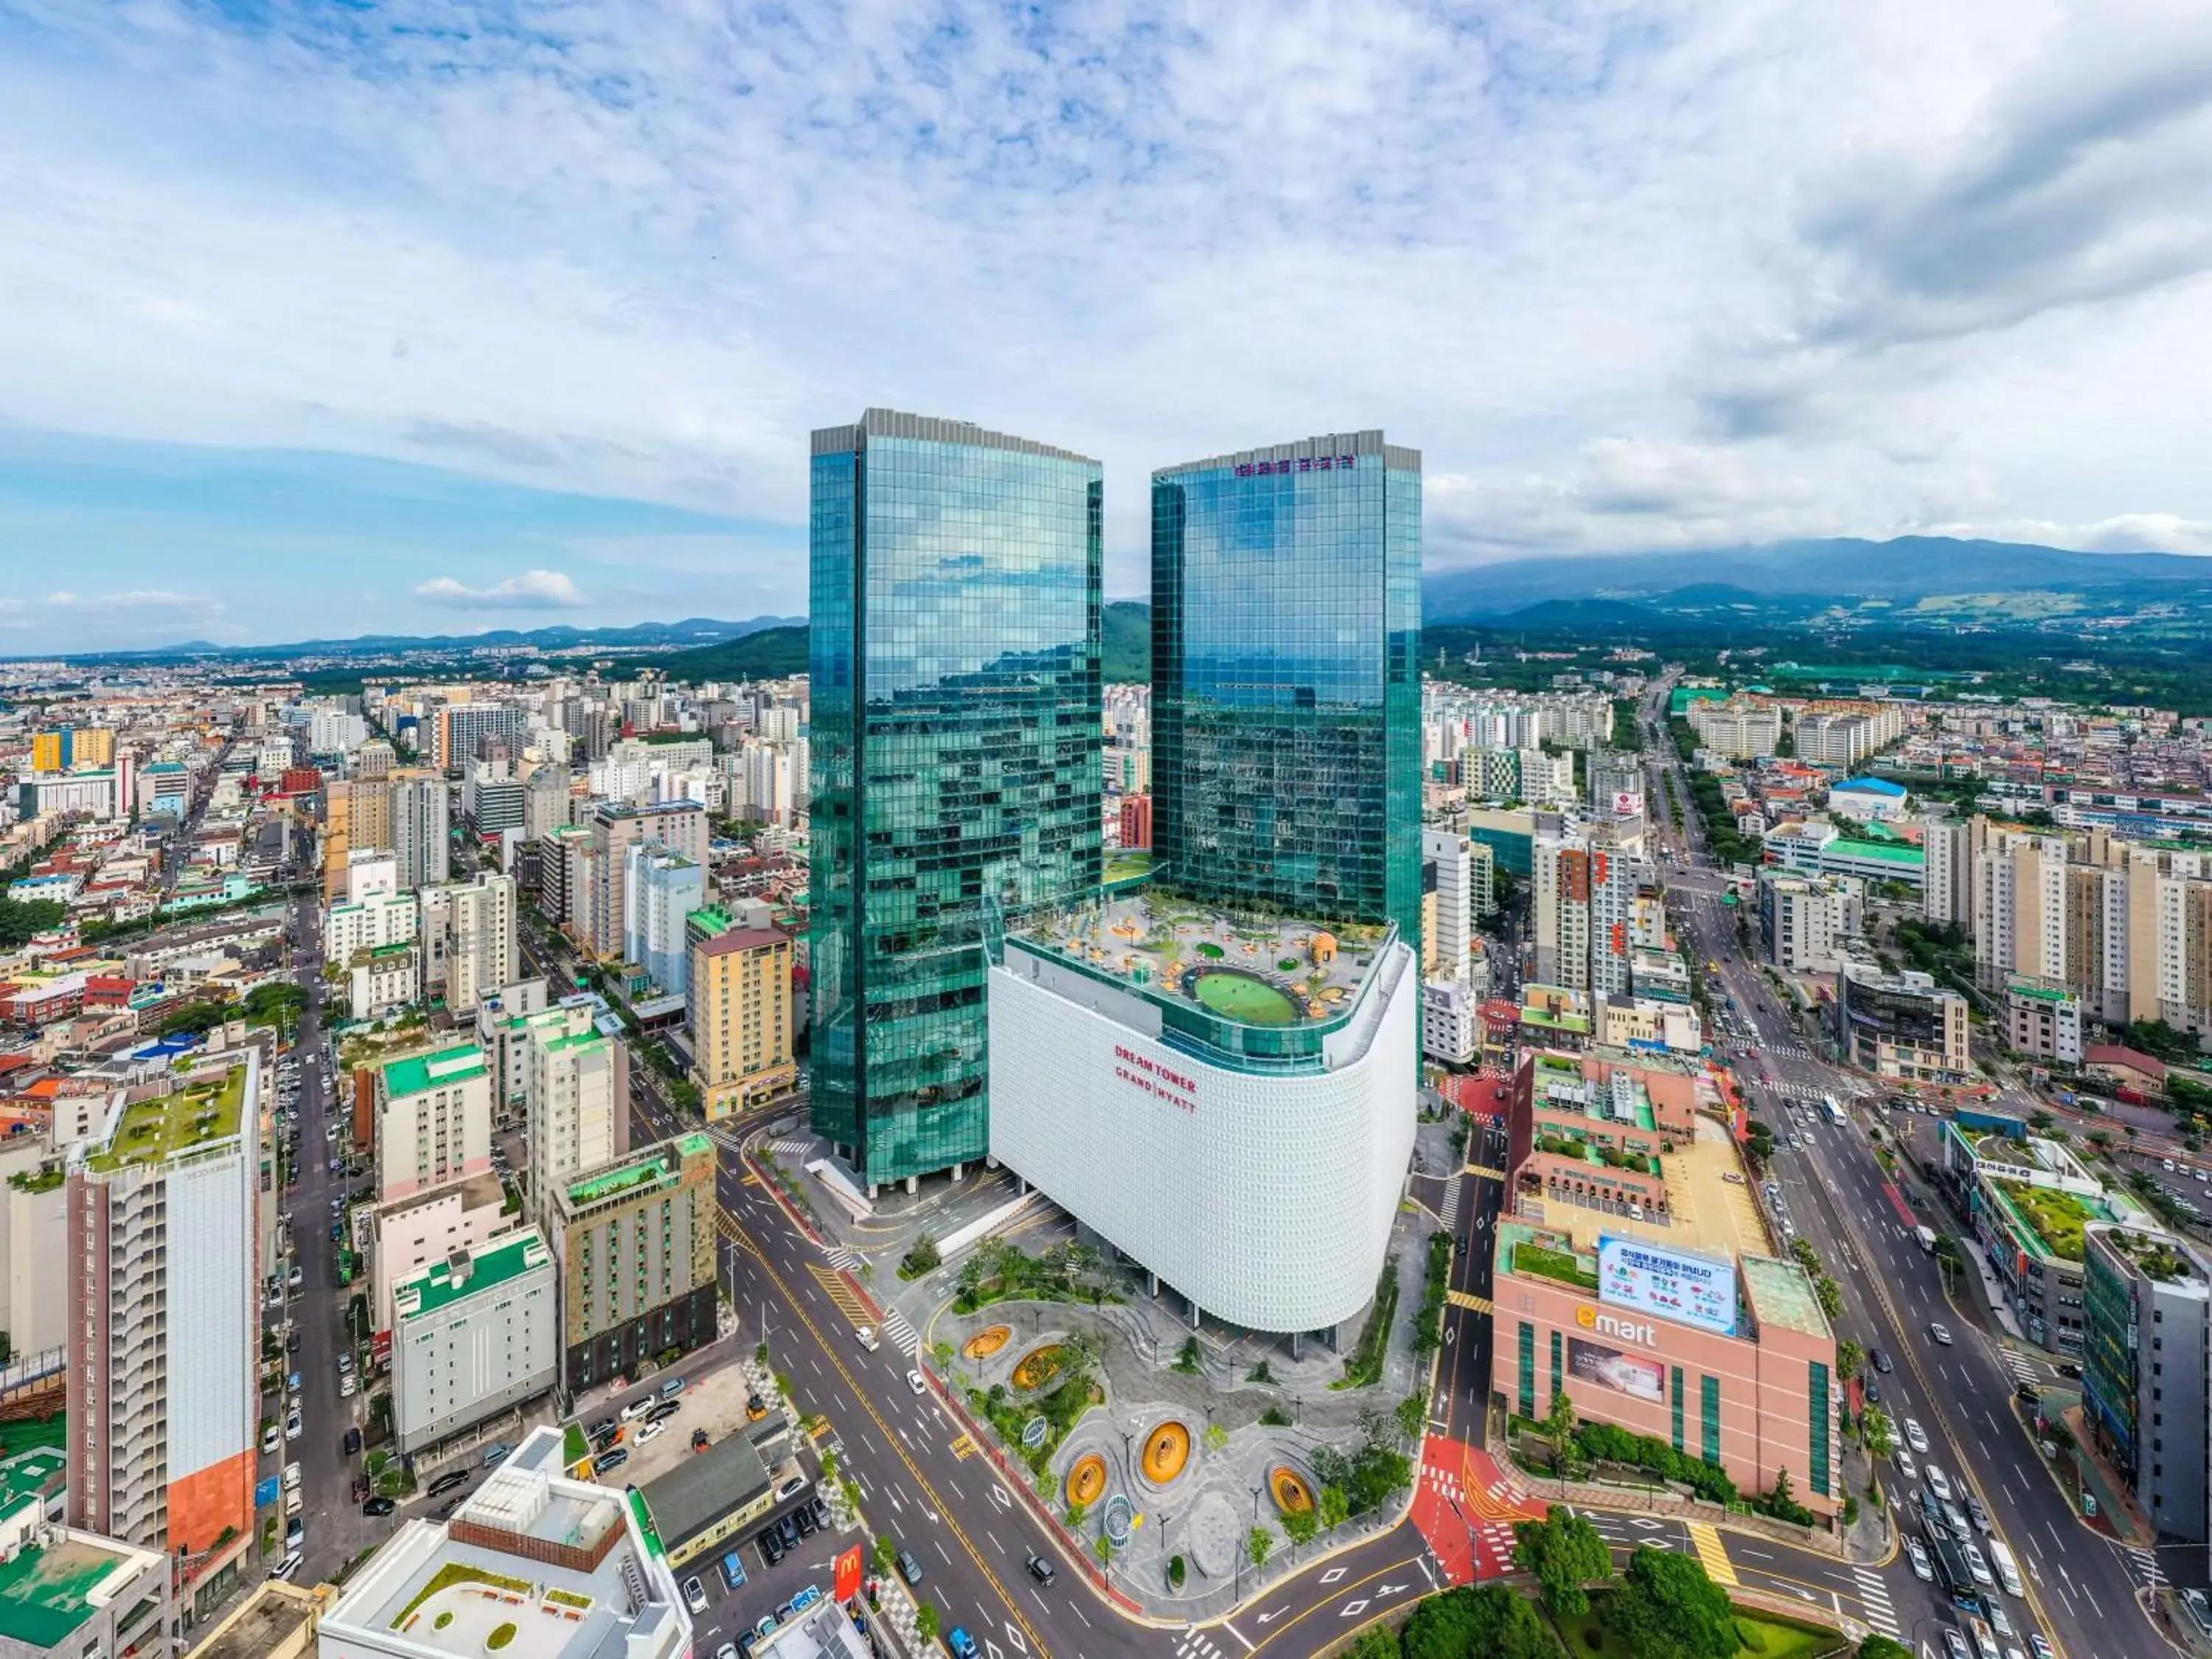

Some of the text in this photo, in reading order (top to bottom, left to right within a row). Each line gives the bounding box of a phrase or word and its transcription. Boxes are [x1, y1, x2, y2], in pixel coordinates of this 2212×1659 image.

[1116, 1044, 1196, 1093] DREAM TOWER
[1116, 1067, 1194, 1113] GRAND HYATT
[1577, 1307, 1655, 1346] emart
